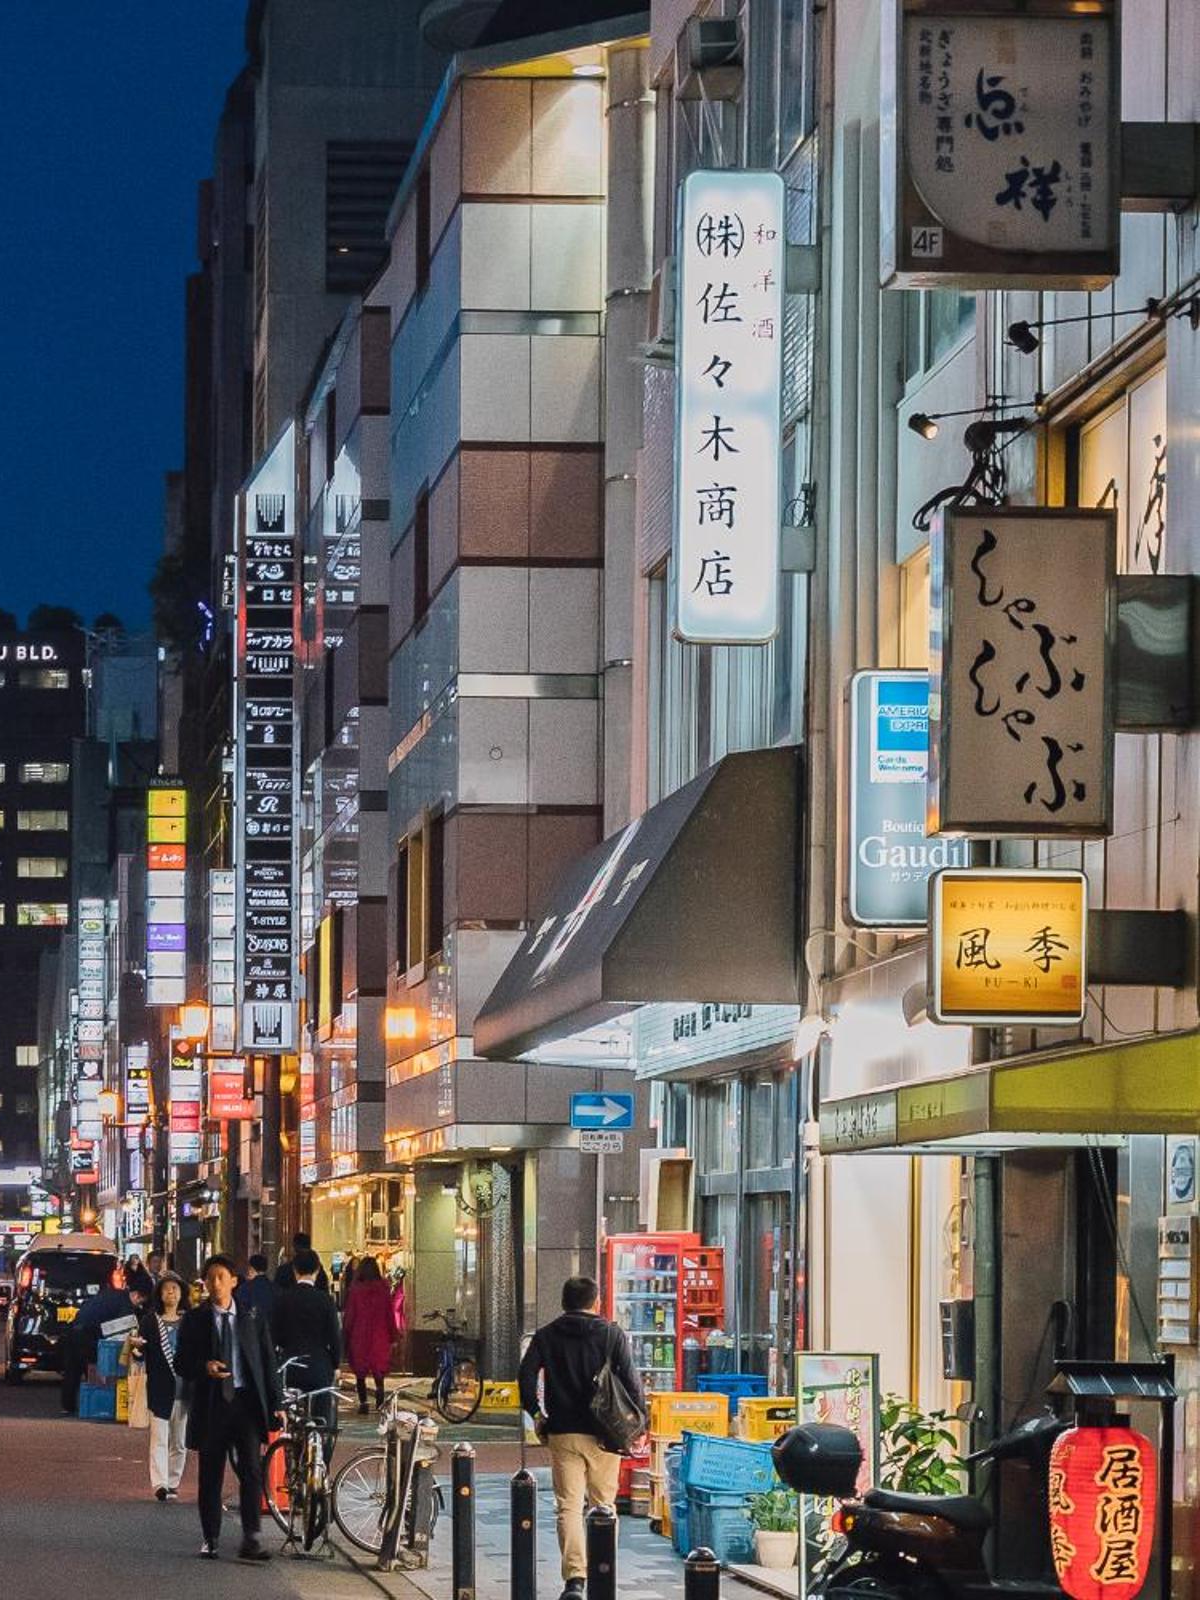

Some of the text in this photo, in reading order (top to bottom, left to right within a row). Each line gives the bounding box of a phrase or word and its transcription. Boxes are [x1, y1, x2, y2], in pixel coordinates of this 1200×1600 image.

[913, 231, 939, 252] 4F
[752, 223, 777, 340] 和洋酒
[16, 645, 59, 661] BLD.
[878, 706, 929, 716] AMERIC
[882, 819, 925, 837] Boutiq
[956, 926, 1070, 974] 風季
[582, 1141, 621, 1152] ここから
[1094, 1446, 1142, 1583] 居酒屋
